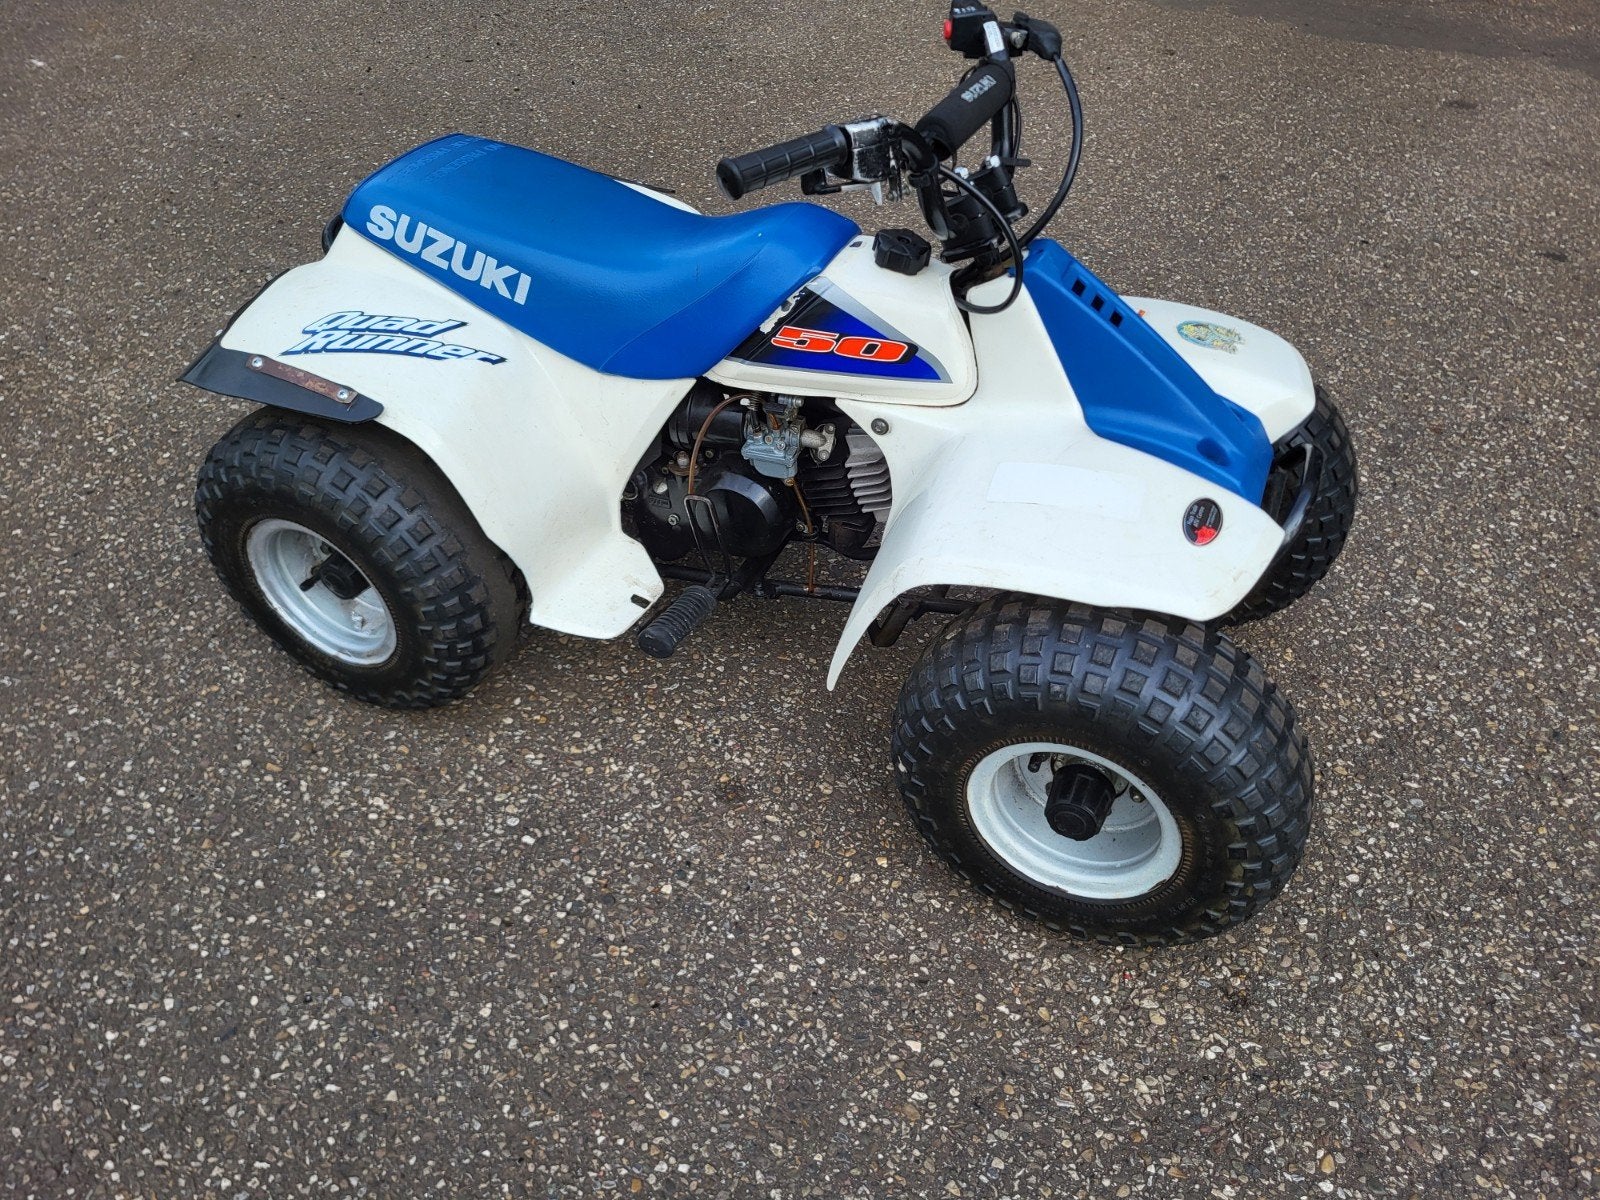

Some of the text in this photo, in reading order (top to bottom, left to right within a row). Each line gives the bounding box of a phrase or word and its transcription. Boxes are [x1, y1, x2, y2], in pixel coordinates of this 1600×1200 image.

[366, 204, 532, 306] SUZUKI
[302, 311, 468, 338] Quad
[278, 330, 507, 365] Runner
[771, 325, 909, 362] 50
